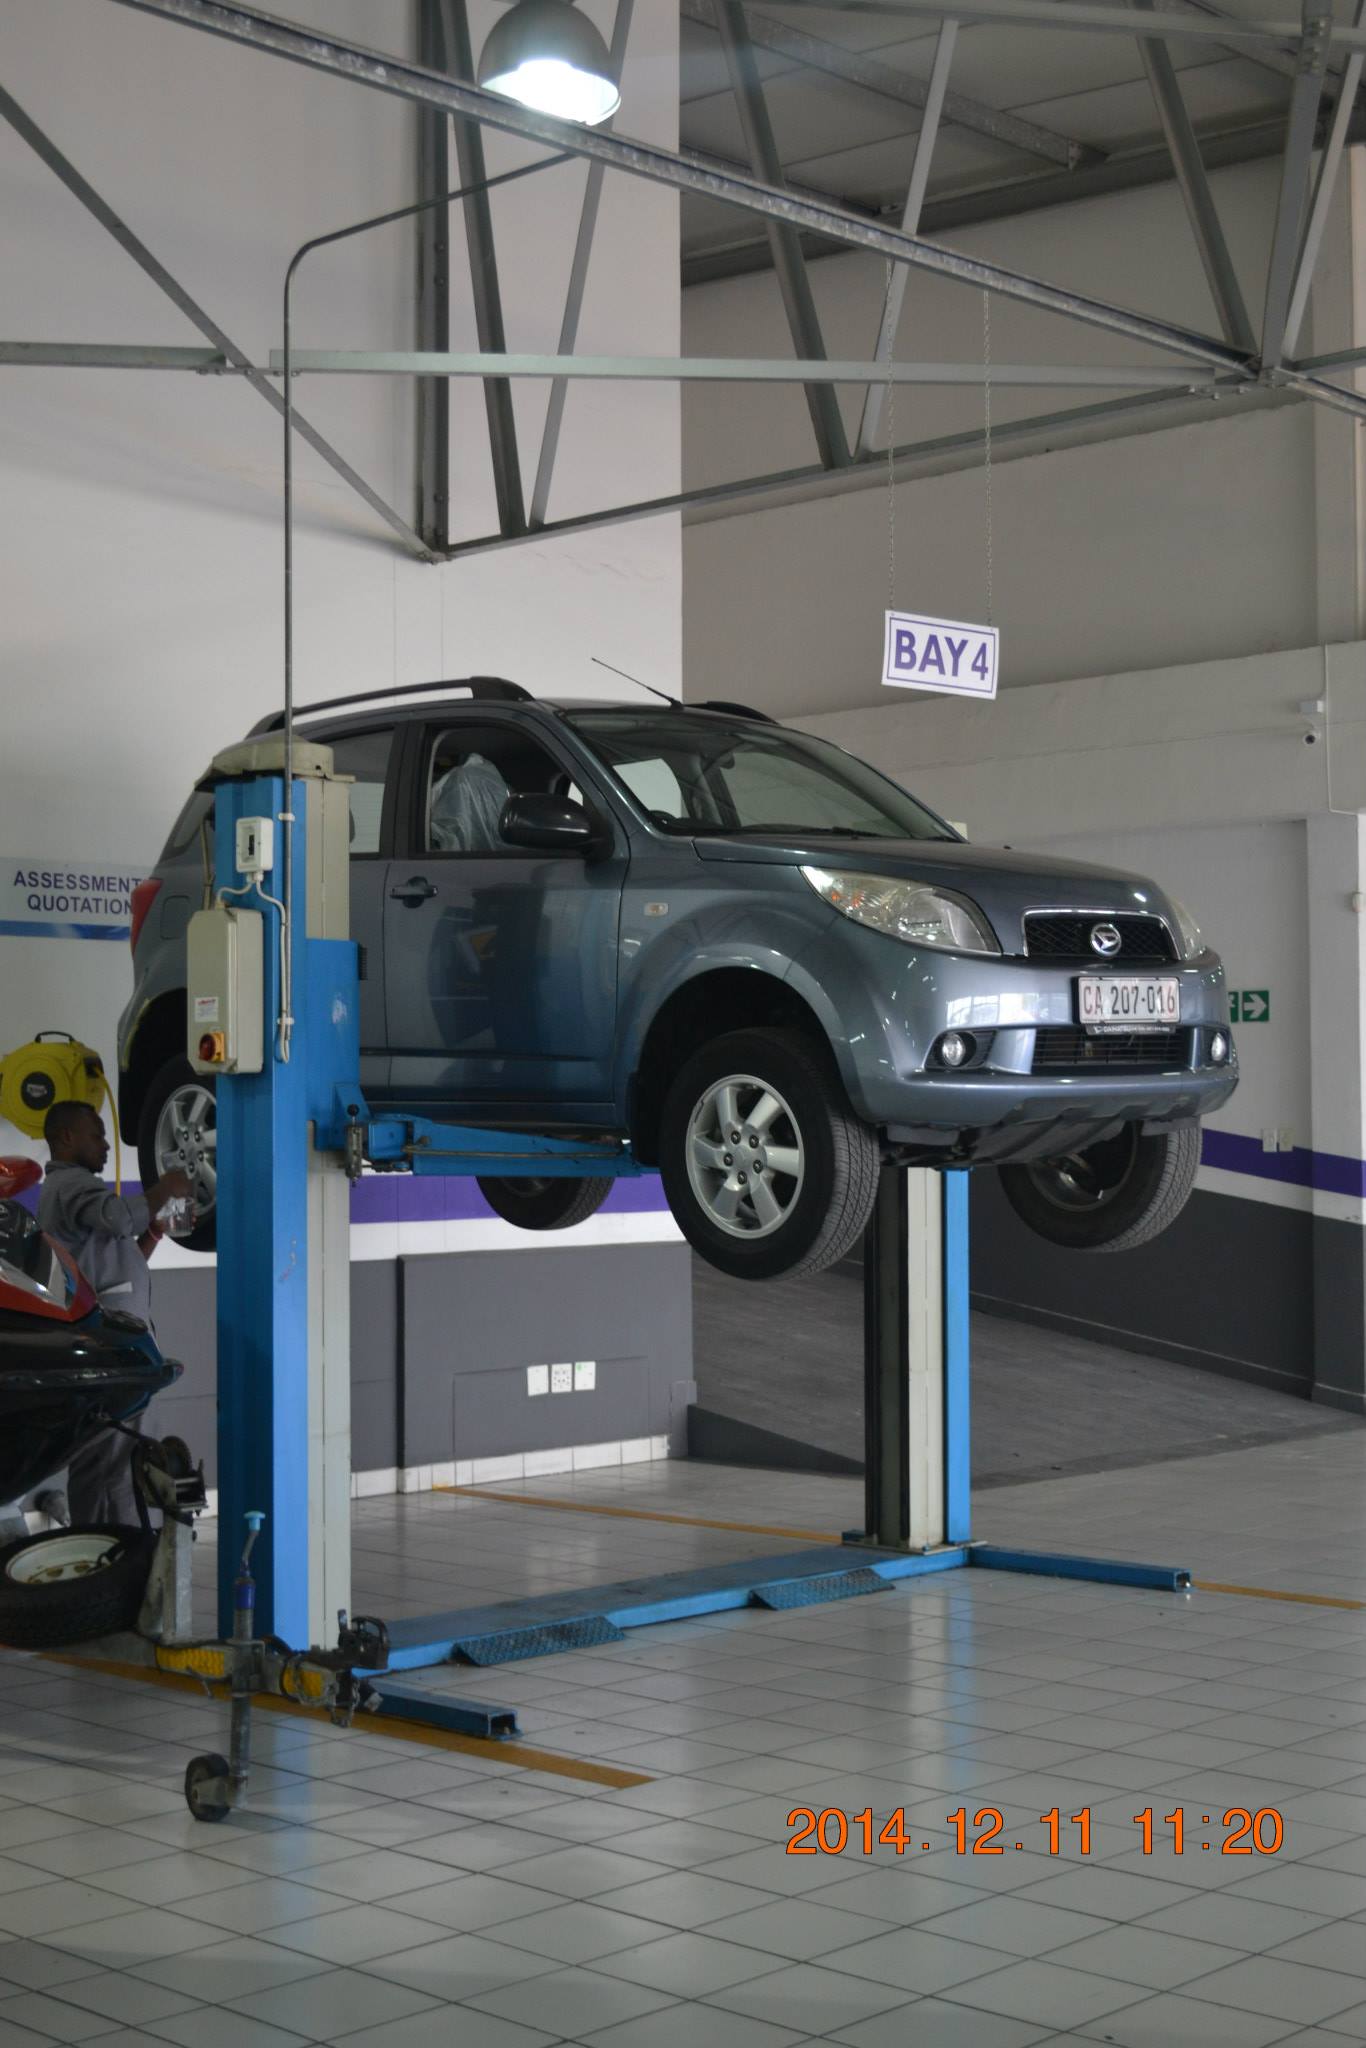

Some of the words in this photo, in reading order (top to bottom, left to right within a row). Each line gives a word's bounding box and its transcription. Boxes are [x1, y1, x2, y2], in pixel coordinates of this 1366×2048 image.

[894, 629, 969, 677] BAY
[971, 642, 989, 681] 4
[1083, 985, 1103, 1015] CA
